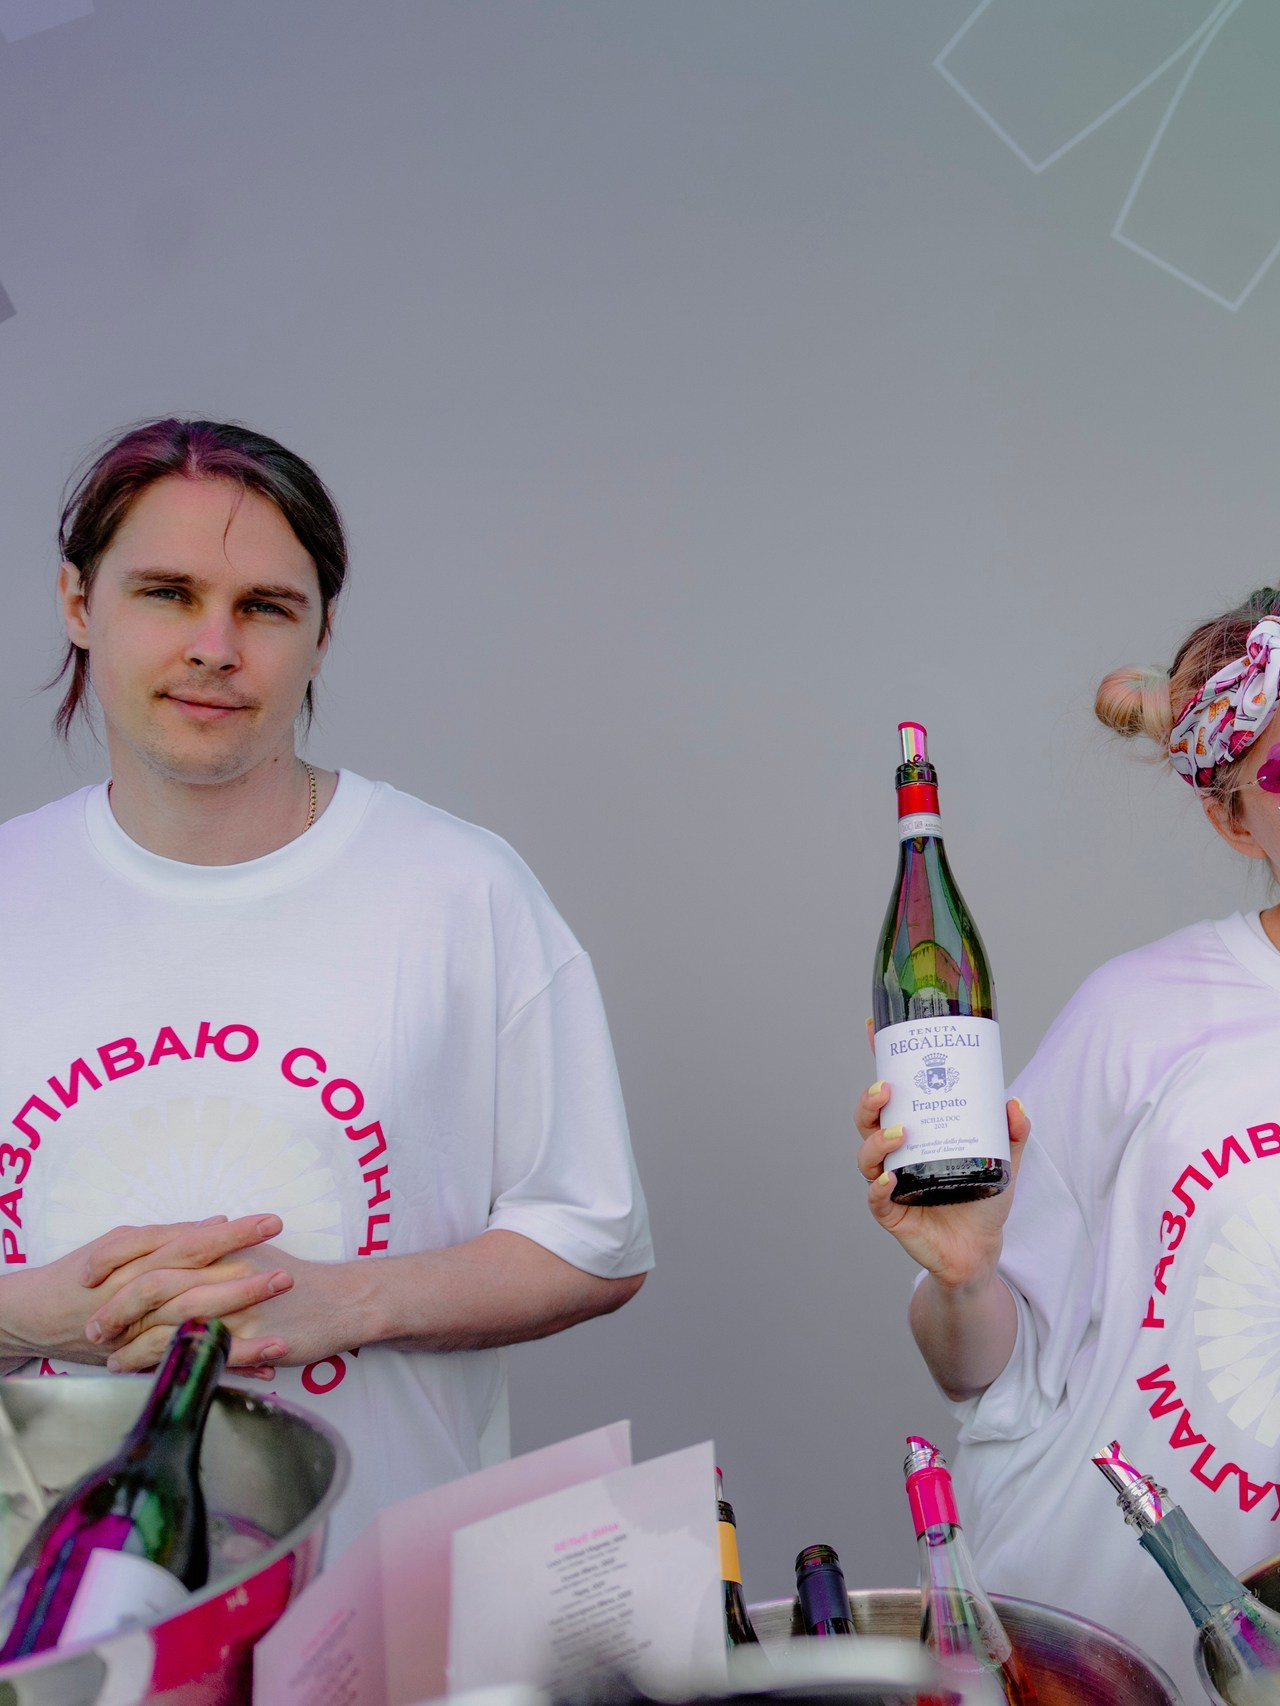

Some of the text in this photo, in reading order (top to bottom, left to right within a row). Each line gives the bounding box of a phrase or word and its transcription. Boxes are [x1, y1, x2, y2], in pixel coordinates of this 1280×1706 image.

[909, 1025, 957, 1036] TENUTA
[890, 1033, 980, 1056] REGALEALI
[912, 1098, 967, 1112] Frappato
[920, 1117, 945, 1125] SICILIA
[0, 1021, 391, 1264] РАЗЛИВАЮ СОЛНЦ
